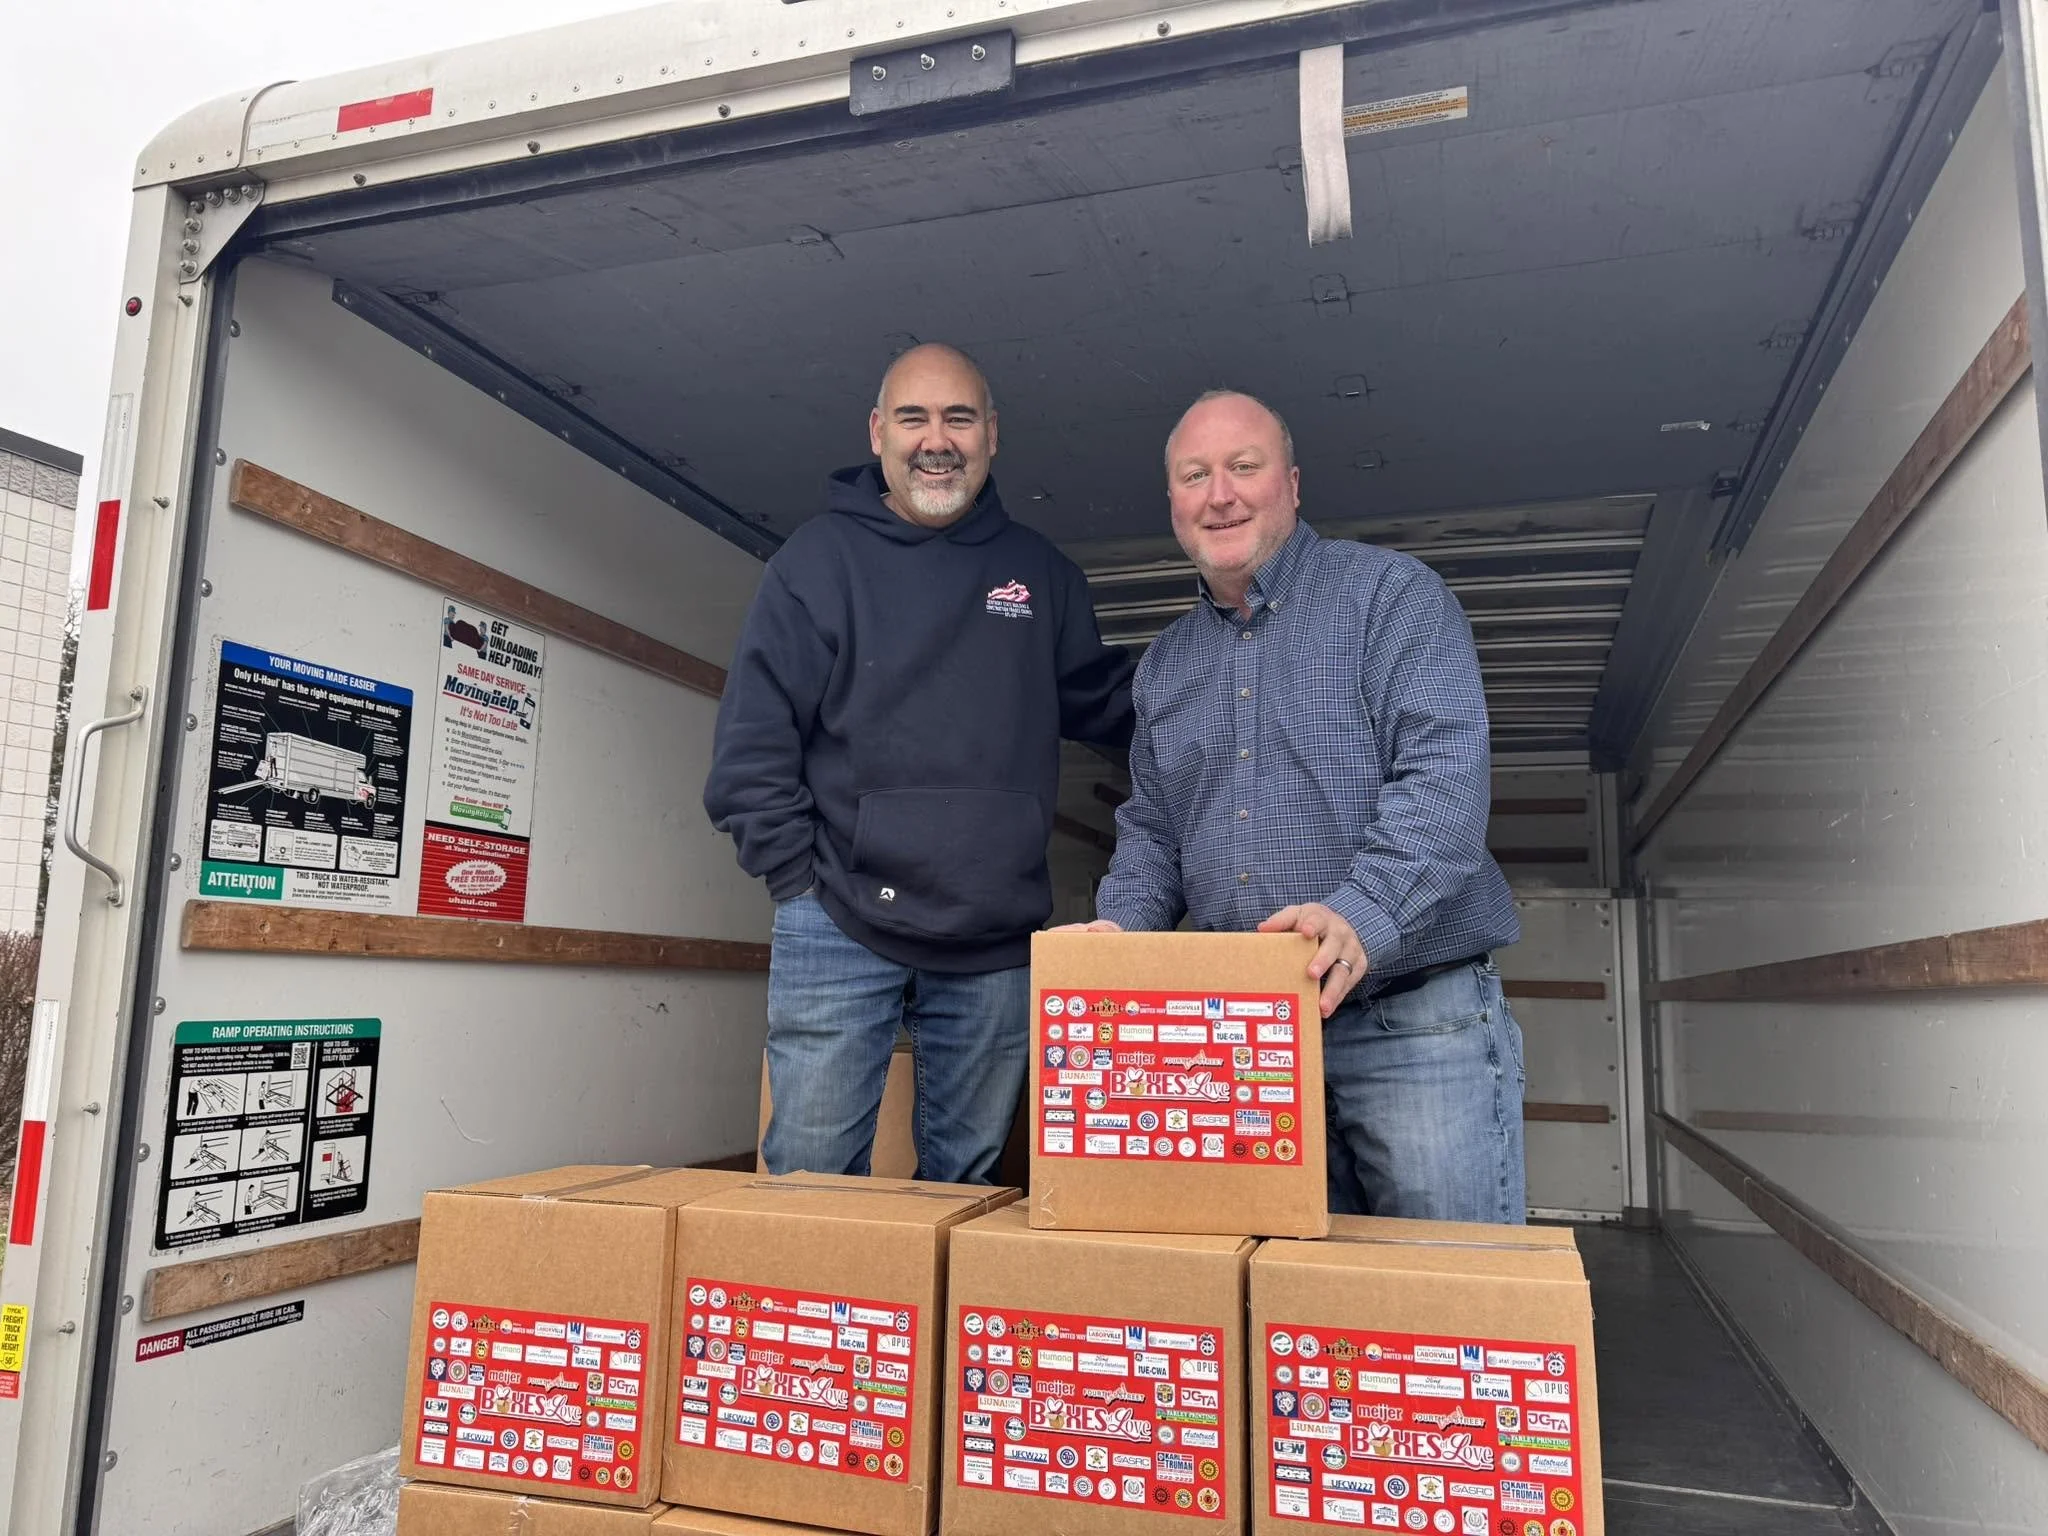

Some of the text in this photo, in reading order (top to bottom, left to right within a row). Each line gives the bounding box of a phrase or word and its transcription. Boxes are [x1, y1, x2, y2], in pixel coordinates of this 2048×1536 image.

[491, 621, 508, 638] GET
[490, 636, 538, 662] UNLOADING
[269, 656, 291, 671] YOUR
[293, 661, 324, 680] MOVING
[326, 671, 348, 685] MADE
[488, 651, 542, 679] HELP TODAY!
[458, 664, 527, 694] SAME DAY SERVICE
[234, 668, 251, 682] Only
[282, 679, 296, 692] has
[297, 683, 308, 694] the
[310, 687, 328, 700] right
[328, 692, 364, 708] equipment
[365, 700, 375, 711] for
[460, 706, 472, 718] It's
[474, 710, 488, 722] Not
[488, 714, 501, 725] Too
[502, 717, 518, 731] Late
[428, 833, 526, 854] NEED SELF-STORAGE
[470, 848, 510, 858] Destination?
[208, 871, 276, 890] ATTENTION
[296, 872, 390, 886] THIS TRUCK IS WATER-RESISTANT,
[331, 882, 369, 892] WATERPROOF.
[448, 896, 498, 908] uhaul.com
[212, 1024, 354, 1038] RAMP OPERATING INSTRUCTIONS
[1120, 1026, 1152, 1035] Humana
[1273, 1025, 1293, 1035] OPUS
[1117, 1051, 1155, 1066] meijer
[1191, 1073, 1230, 1101] Love
[1044, 1089, 1071, 1100] USW
[1244, 1117, 1270, 1125] TRUMAN
[3, 1314, 24, 1324] FREIGHT
[186, 1305, 296, 1339] ALL PASSENGERS MUST RIDE IN CAB.
[4, 1324, 20, 1332] TRUCK
[186, 1334, 214, 1346] Passengers
[220, 1329, 233, 1338] cargo
[256, 1320, 272, 1328] serious
[4, 1334, 18, 1342] DECK
[1089, 1332, 1121, 1340] LABORVILLE
[1, 1342, 20, 1352] HEIGHT
[139, 1336, 180, 1356] DANGER
[892, 1337, 910, 1348] OPUS
[623, 1353, 641, 1364] OPUS
[750, 1350, 784, 1365] meijer
[1040, 1351, 1072, 1362] Humana
[1416, 1352, 1455, 1360] LABORVILLE
[1138, 1366, 1166, 1376] IUE-CWA
[1196, 1363, 1218, 1373] OPUS
[489, 1369, 521, 1385] meijer
[1360, 1373, 1398, 1384] Humana
[1037, 1381, 1074, 1397] meijer
[1407, 1382, 1436, 1390] Community
[1544, 1382, 1570, 1394] OPUS
[814, 1378, 848, 1407] Love
[1476, 1388, 1510, 1398] IUE-CWA
[550, 1395, 581, 1423] Love
[1358, 1404, 1402, 1422] meijer
[964, 1414, 990, 1426] USW
[1108, 1408, 1151, 1440] Love
[1414, 1414, 1484, 1426] FOURTH STREET
[1184, 1430, 1216, 1440] Autotruck
[1274, 1441, 1304, 1454] USW
[1442, 1434, 1494, 1468] Love
[1166, 1460, 1192, 1470] TRUMAN
[1532, 1456, 1568, 1467] Autotruck
[1510, 1482, 1528, 1490] KARL
[1512, 1490, 1543, 1500] TRUMAN
